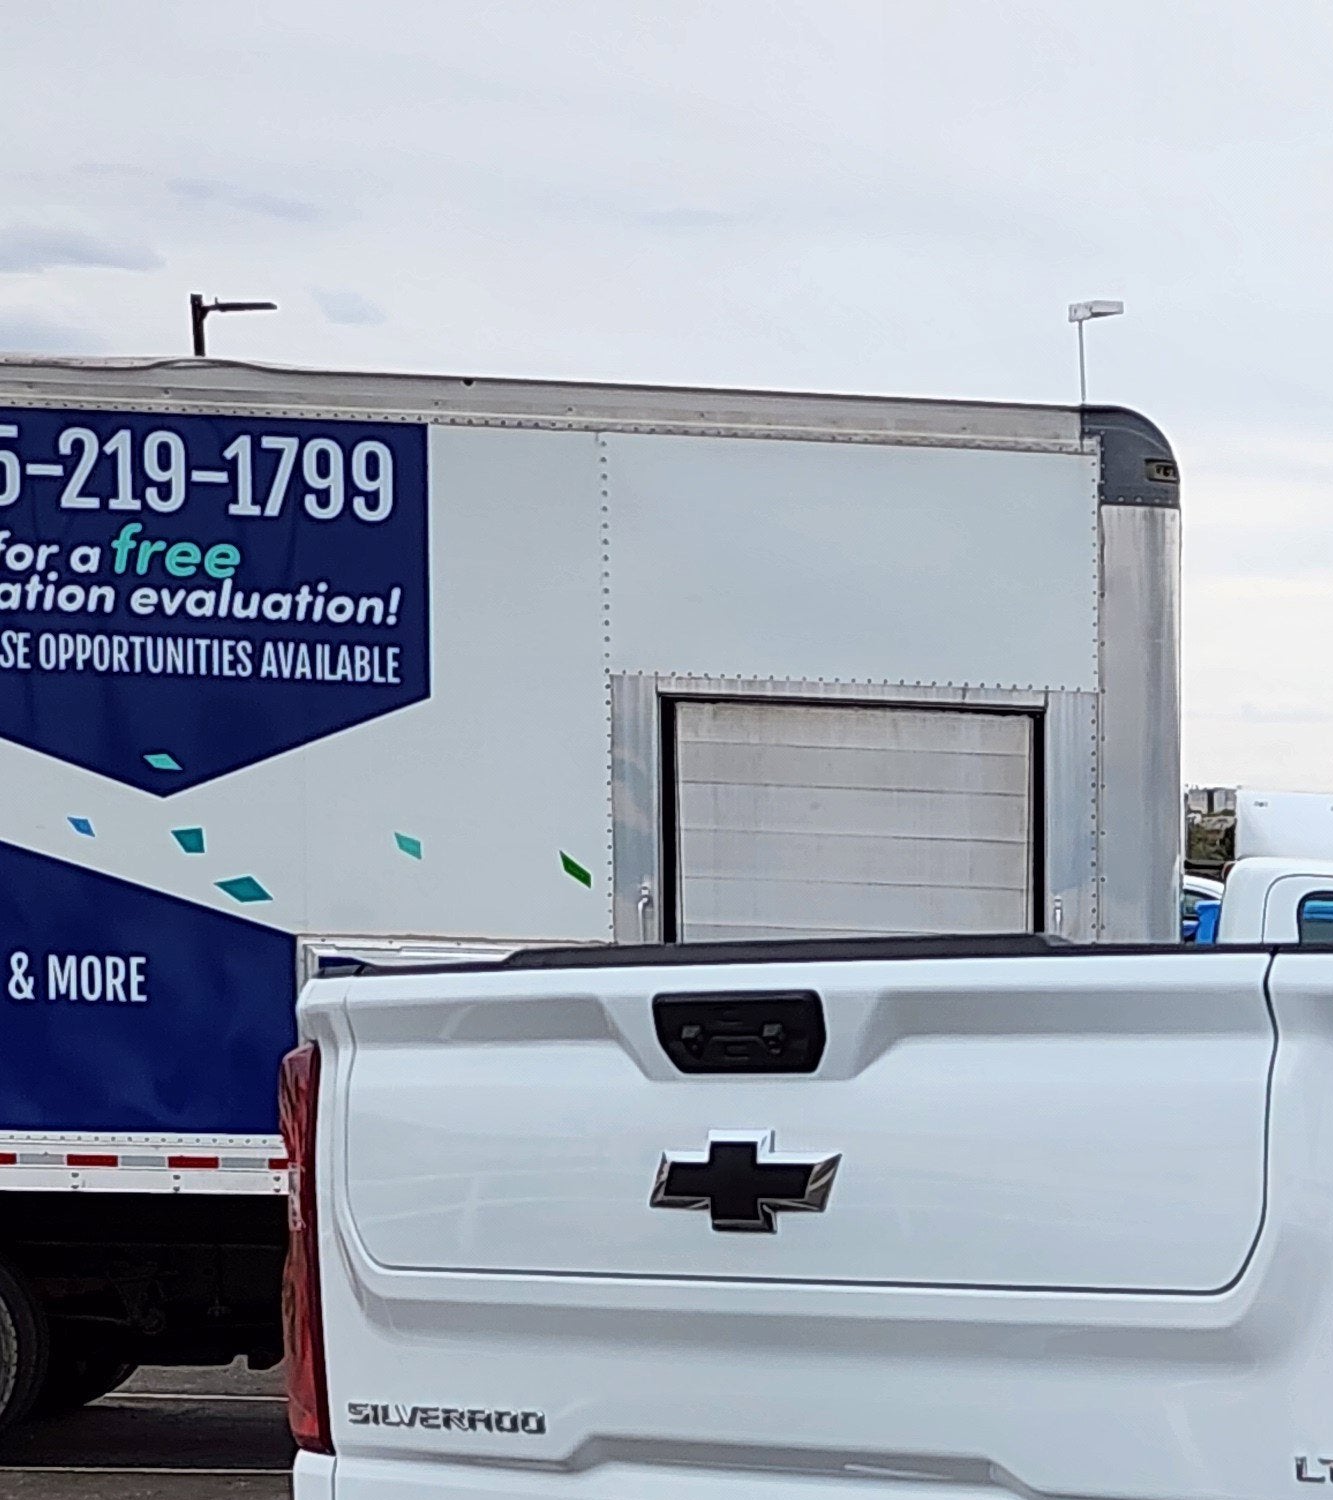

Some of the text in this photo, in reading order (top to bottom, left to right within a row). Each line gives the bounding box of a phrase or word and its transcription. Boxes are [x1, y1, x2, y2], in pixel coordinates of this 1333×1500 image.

[69, 546, 101, 573] a
[111, 522, 241, 579] free
[130, 577, 401, 626] evaluation!
[38, 632, 253, 678] OPPORTUNITIES
[260, 641, 401, 684] AVAILABLE
[7, 950, 148, 1002] & MORE
[347, 1402, 546, 1435] SILVERADO
